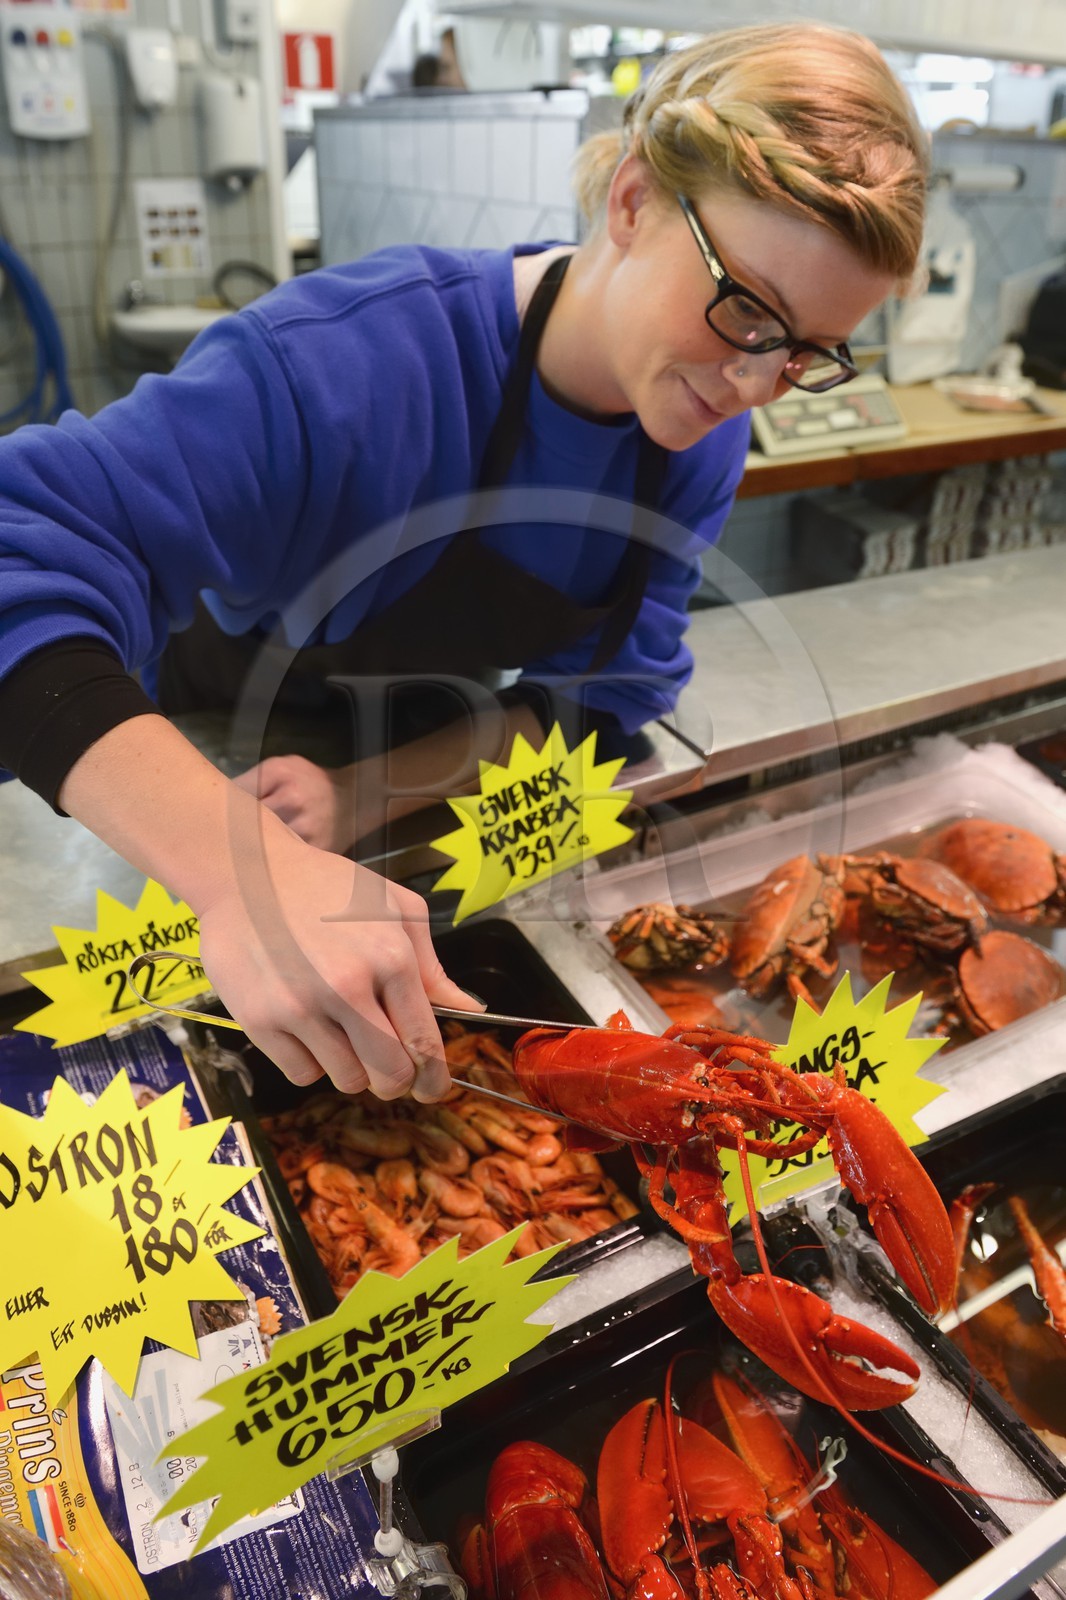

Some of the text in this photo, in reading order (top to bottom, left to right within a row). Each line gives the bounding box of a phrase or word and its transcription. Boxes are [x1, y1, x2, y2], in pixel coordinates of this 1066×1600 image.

[479, 762, 571, 827] SVENSK
[480, 795, 583, 857] KRABBA
[76, 941, 136, 973] RÖKTA
[5, 1286, 50, 1321] ELLER
[244, 1279, 469, 1408] SVENSK
[226, 1300, 497, 1447] HUMMER
[1, 1362, 67, 1485] Prins
[55, 1480, 80, 1532] SINCE 1880
[335, 1493, 352, 1526] Koninklijke
[347, 1525, 358, 1541] Prins
[251, 1543, 266, 1572] delicacies
[294, 1516, 312, 1548] Koninklijke
[307, 1548, 317, 1563] Prins
[226, 1545, 243, 1579] Koninklijke
[238, 1578, 248, 1594] Prins
[275, 1563, 285, 1579] Prins
